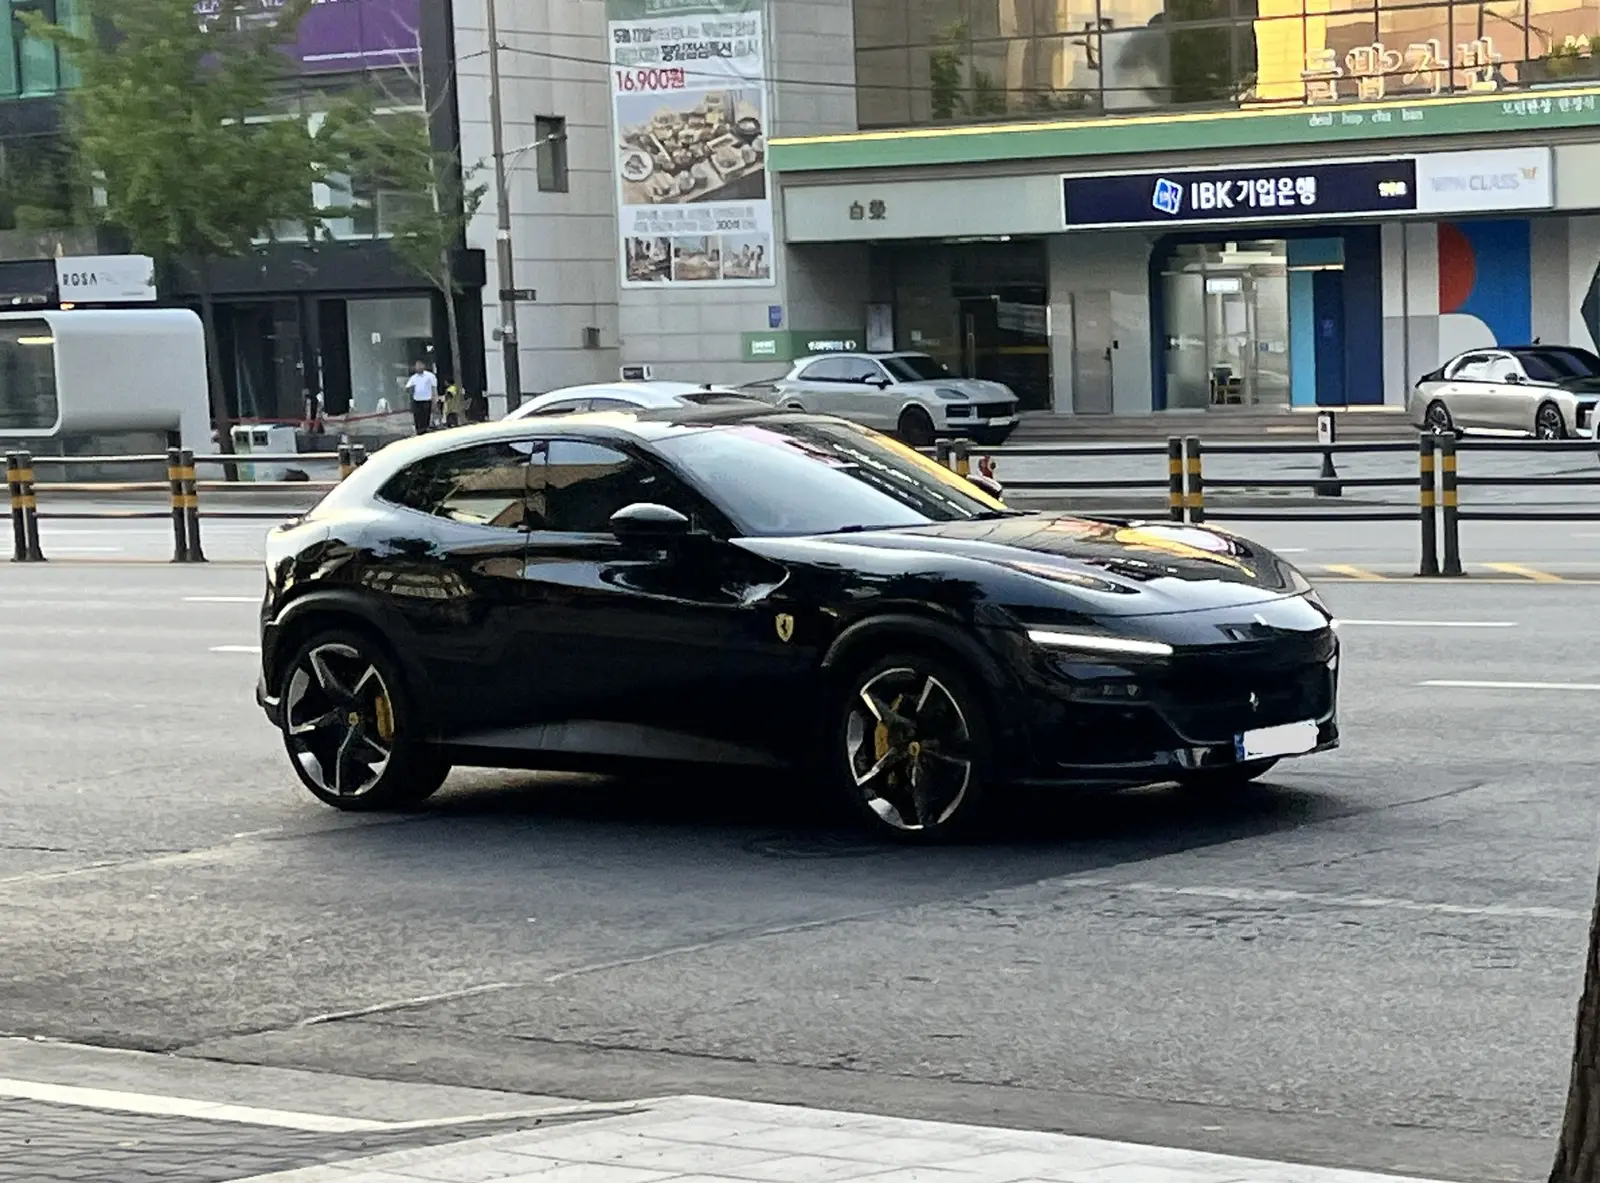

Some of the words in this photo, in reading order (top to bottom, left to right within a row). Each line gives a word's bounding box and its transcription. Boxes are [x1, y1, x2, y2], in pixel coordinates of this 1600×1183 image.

[616, 67, 685, 91] 16,900원
[1469, 174, 1519, 191] CLASS
[1191, 181, 1235, 210] IBK
[1236, 176, 1317, 207] 기업은행
[62, 272, 98, 287] ROSA
